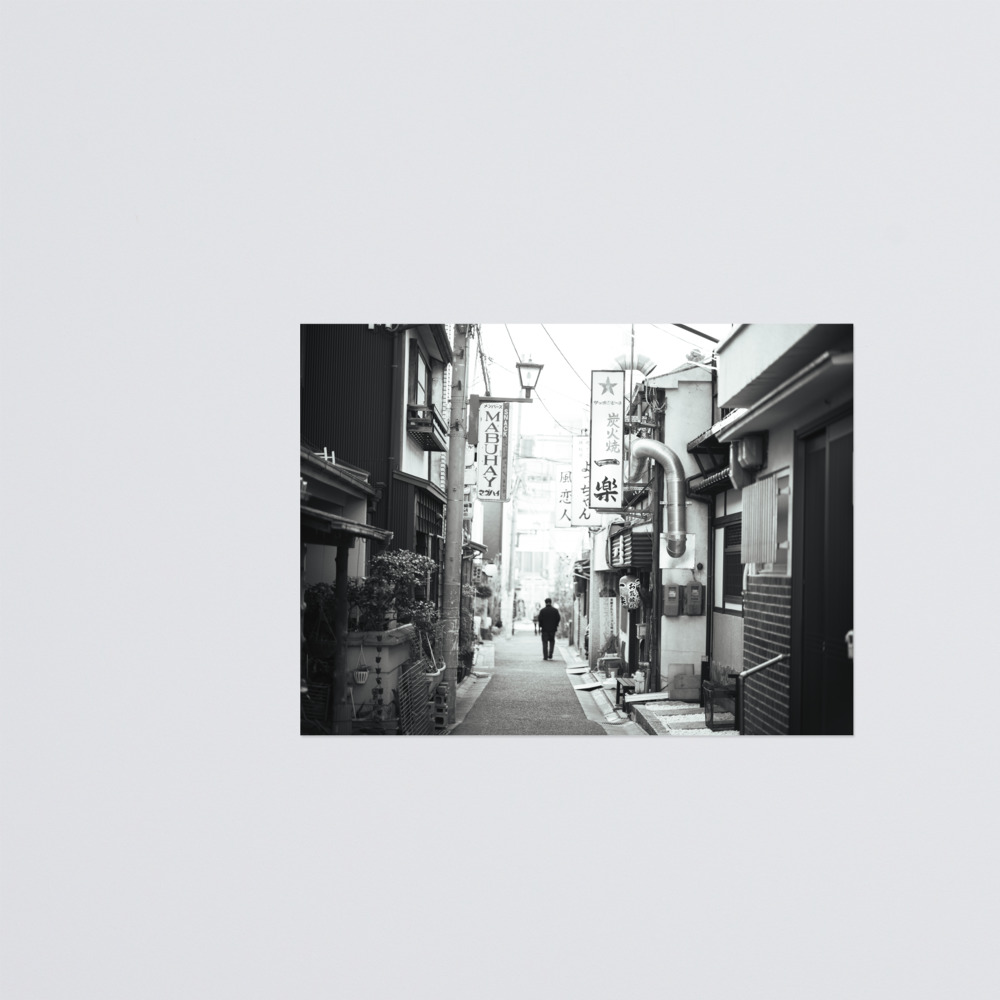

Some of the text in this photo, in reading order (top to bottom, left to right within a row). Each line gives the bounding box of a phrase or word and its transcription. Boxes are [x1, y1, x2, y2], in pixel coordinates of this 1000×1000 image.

[483, 411, 500, 487] MABUHAY
[605, 412, 620, 453] 炭火焼
[594, 458, 620, 502] 一楽
